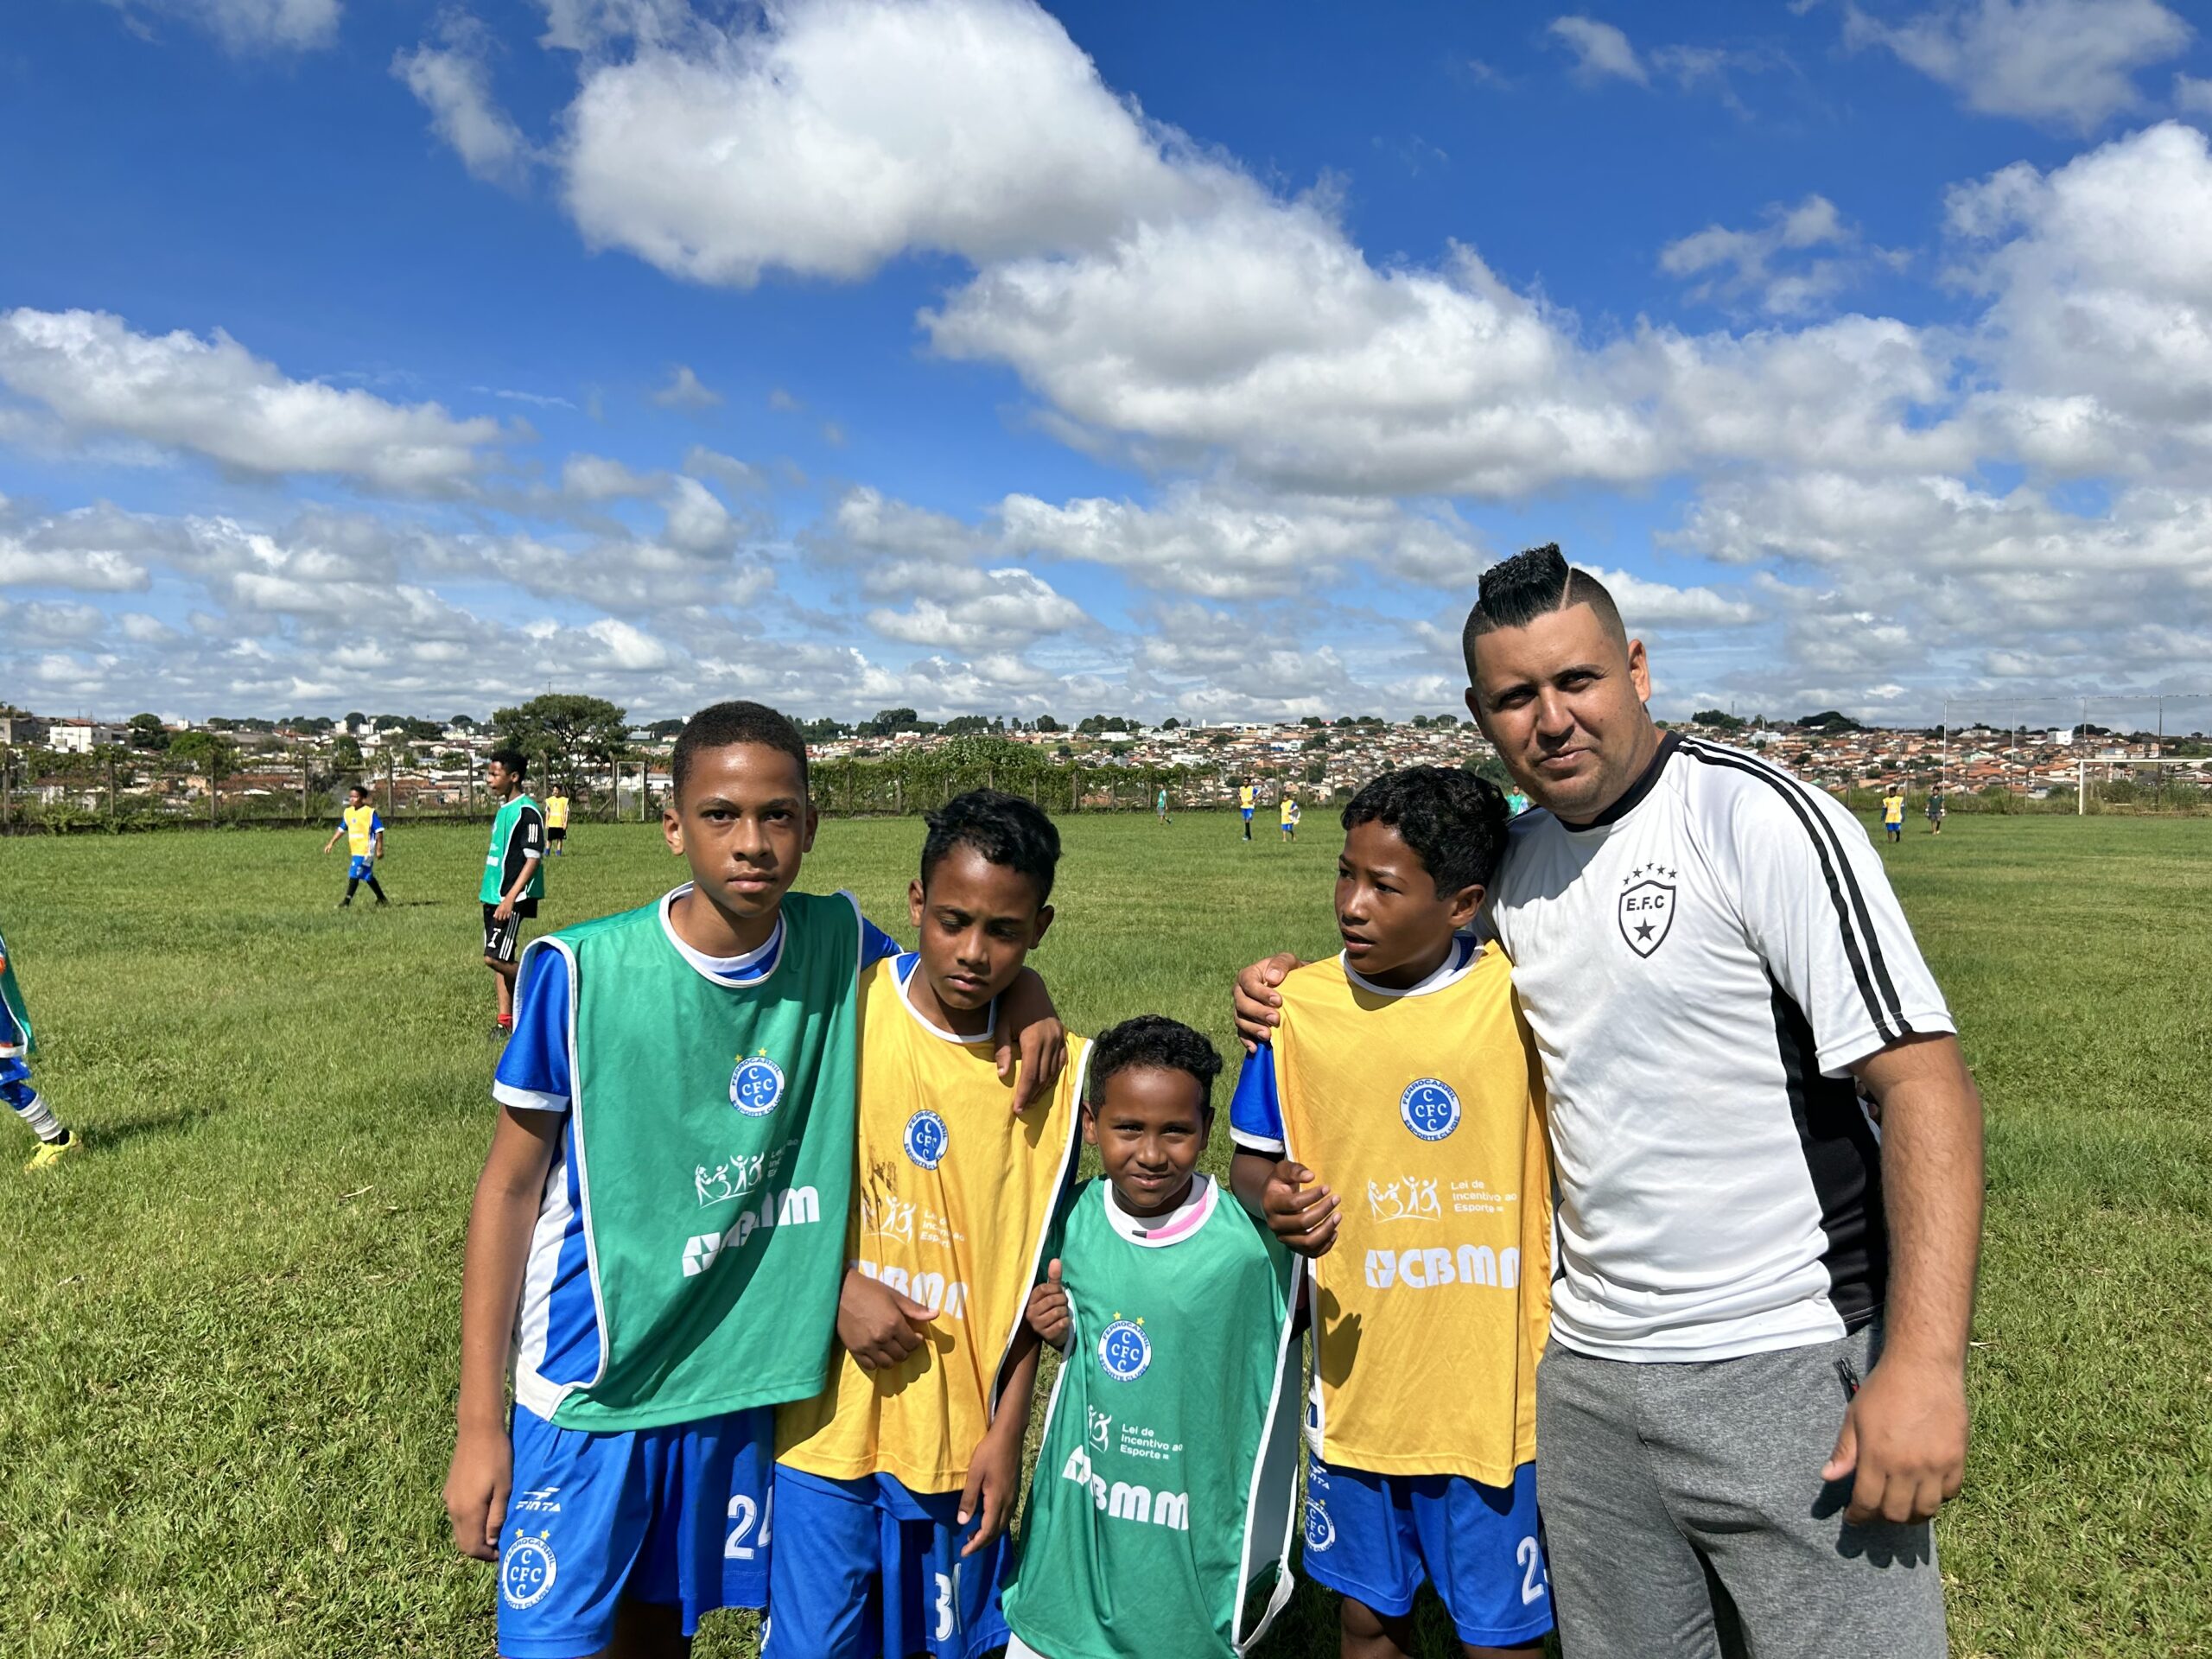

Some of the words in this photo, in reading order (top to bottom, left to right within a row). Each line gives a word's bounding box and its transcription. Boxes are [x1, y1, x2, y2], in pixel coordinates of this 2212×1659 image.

[1626, 894, 1665, 912] E.F.C
[1402, 1079, 1457, 1105] FERROCARRIL
[1422, 1089, 1433, 1103] C
[1414, 1103, 1448, 1118] CFC
[1404, 1118, 1439, 1141] ESPORTE
[1439, 1115, 1459, 1139] CLUBE
[1427, 1118, 1438, 1131] C
[1451, 1180, 1468, 1190] Lei
[1471, 1179, 1484, 1189] de
[1452, 1192, 1502, 1202] Incentivo
[1504, 1192, 1517, 1202] ao
[1454, 1203, 1495, 1213] Esporte
[1103, 1321, 1150, 1351] FERROCARRIL
[1122, 1332, 1131, 1344] C
[1111, 1343, 1140, 1361] CFC
[1116, 1359, 1127, 1372] C
[1122, 1423, 1138, 1434] Lei
[1141, 1427, 1154, 1437] de
[1121, 1433, 1169, 1451] Incentivo
[1172, 1443, 1183, 1452] ao
[1120, 1444, 1161, 1460] Esporte
[1090, 1471, 1190, 1532] BMM
[521, 1549, 533, 1564] C
[510, 1566, 543, 1582] CFC
[1516, 1535, 1548, 1605] 2
[516, 1584, 527, 1598] C
